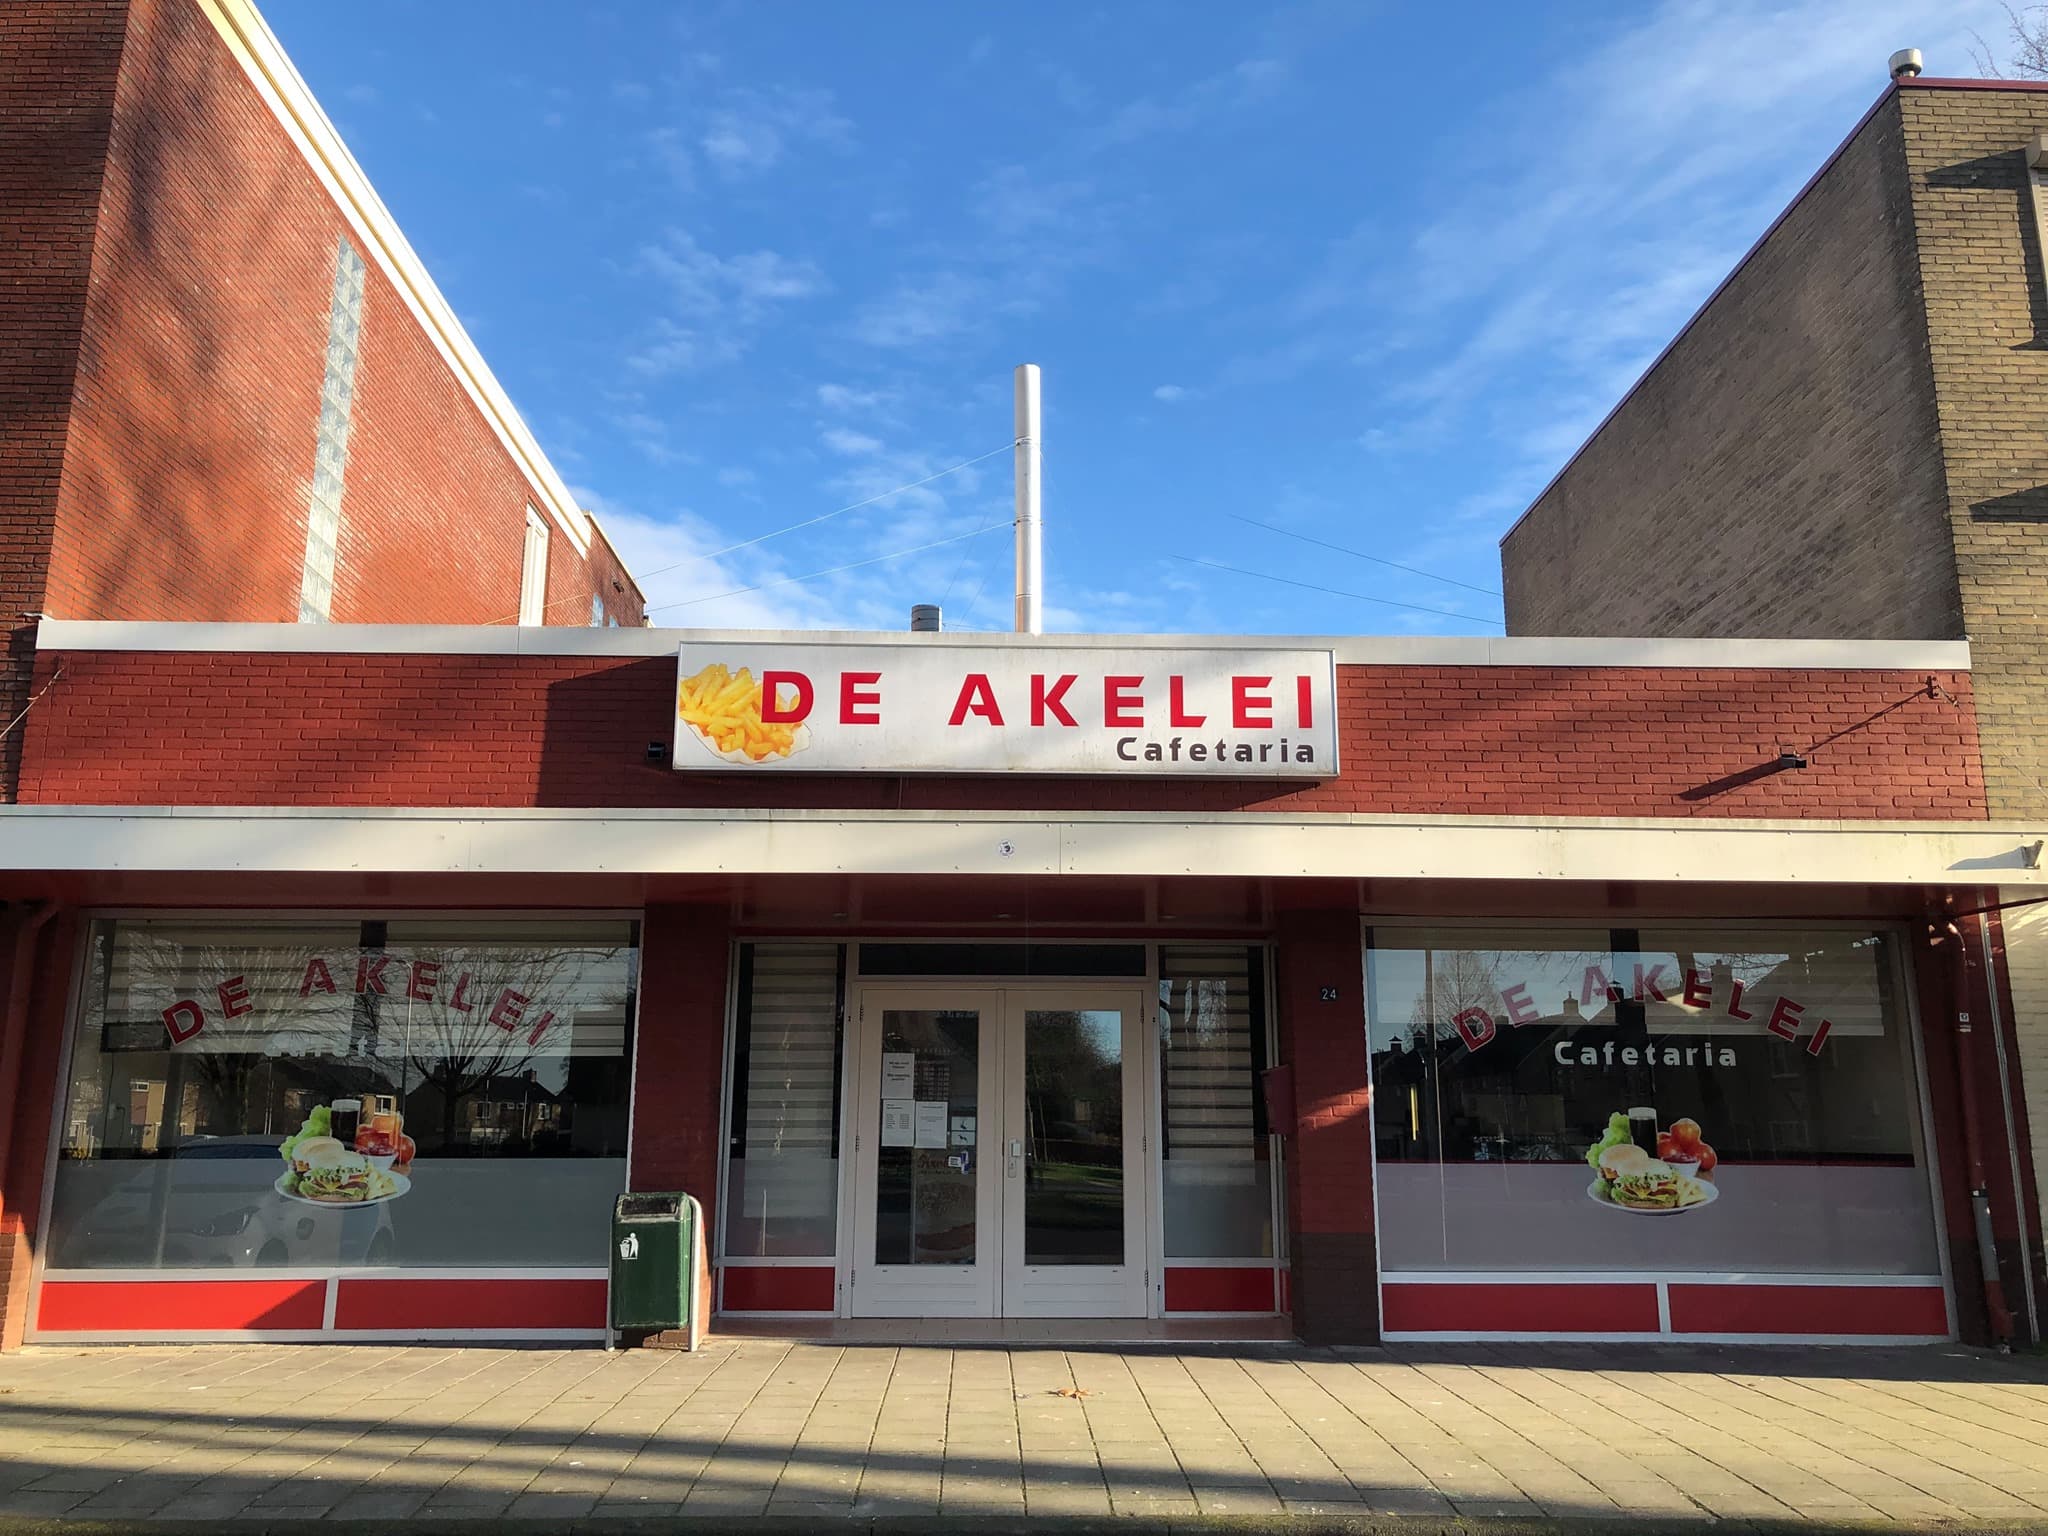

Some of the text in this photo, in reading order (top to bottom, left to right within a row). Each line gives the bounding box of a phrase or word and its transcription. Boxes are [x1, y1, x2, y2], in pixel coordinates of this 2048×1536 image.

[761, 671, 1313, 729] DE AKELEI
[1117, 737, 1315, 763] Cafetaria
[161, 957, 555, 1046] DE AKELEI
[1321, 988, 1337, 1000] 24
[1450, 962, 1833, 1057] DE AKELEI
[1554, 1041, 1738, 1067] Cafetaria
